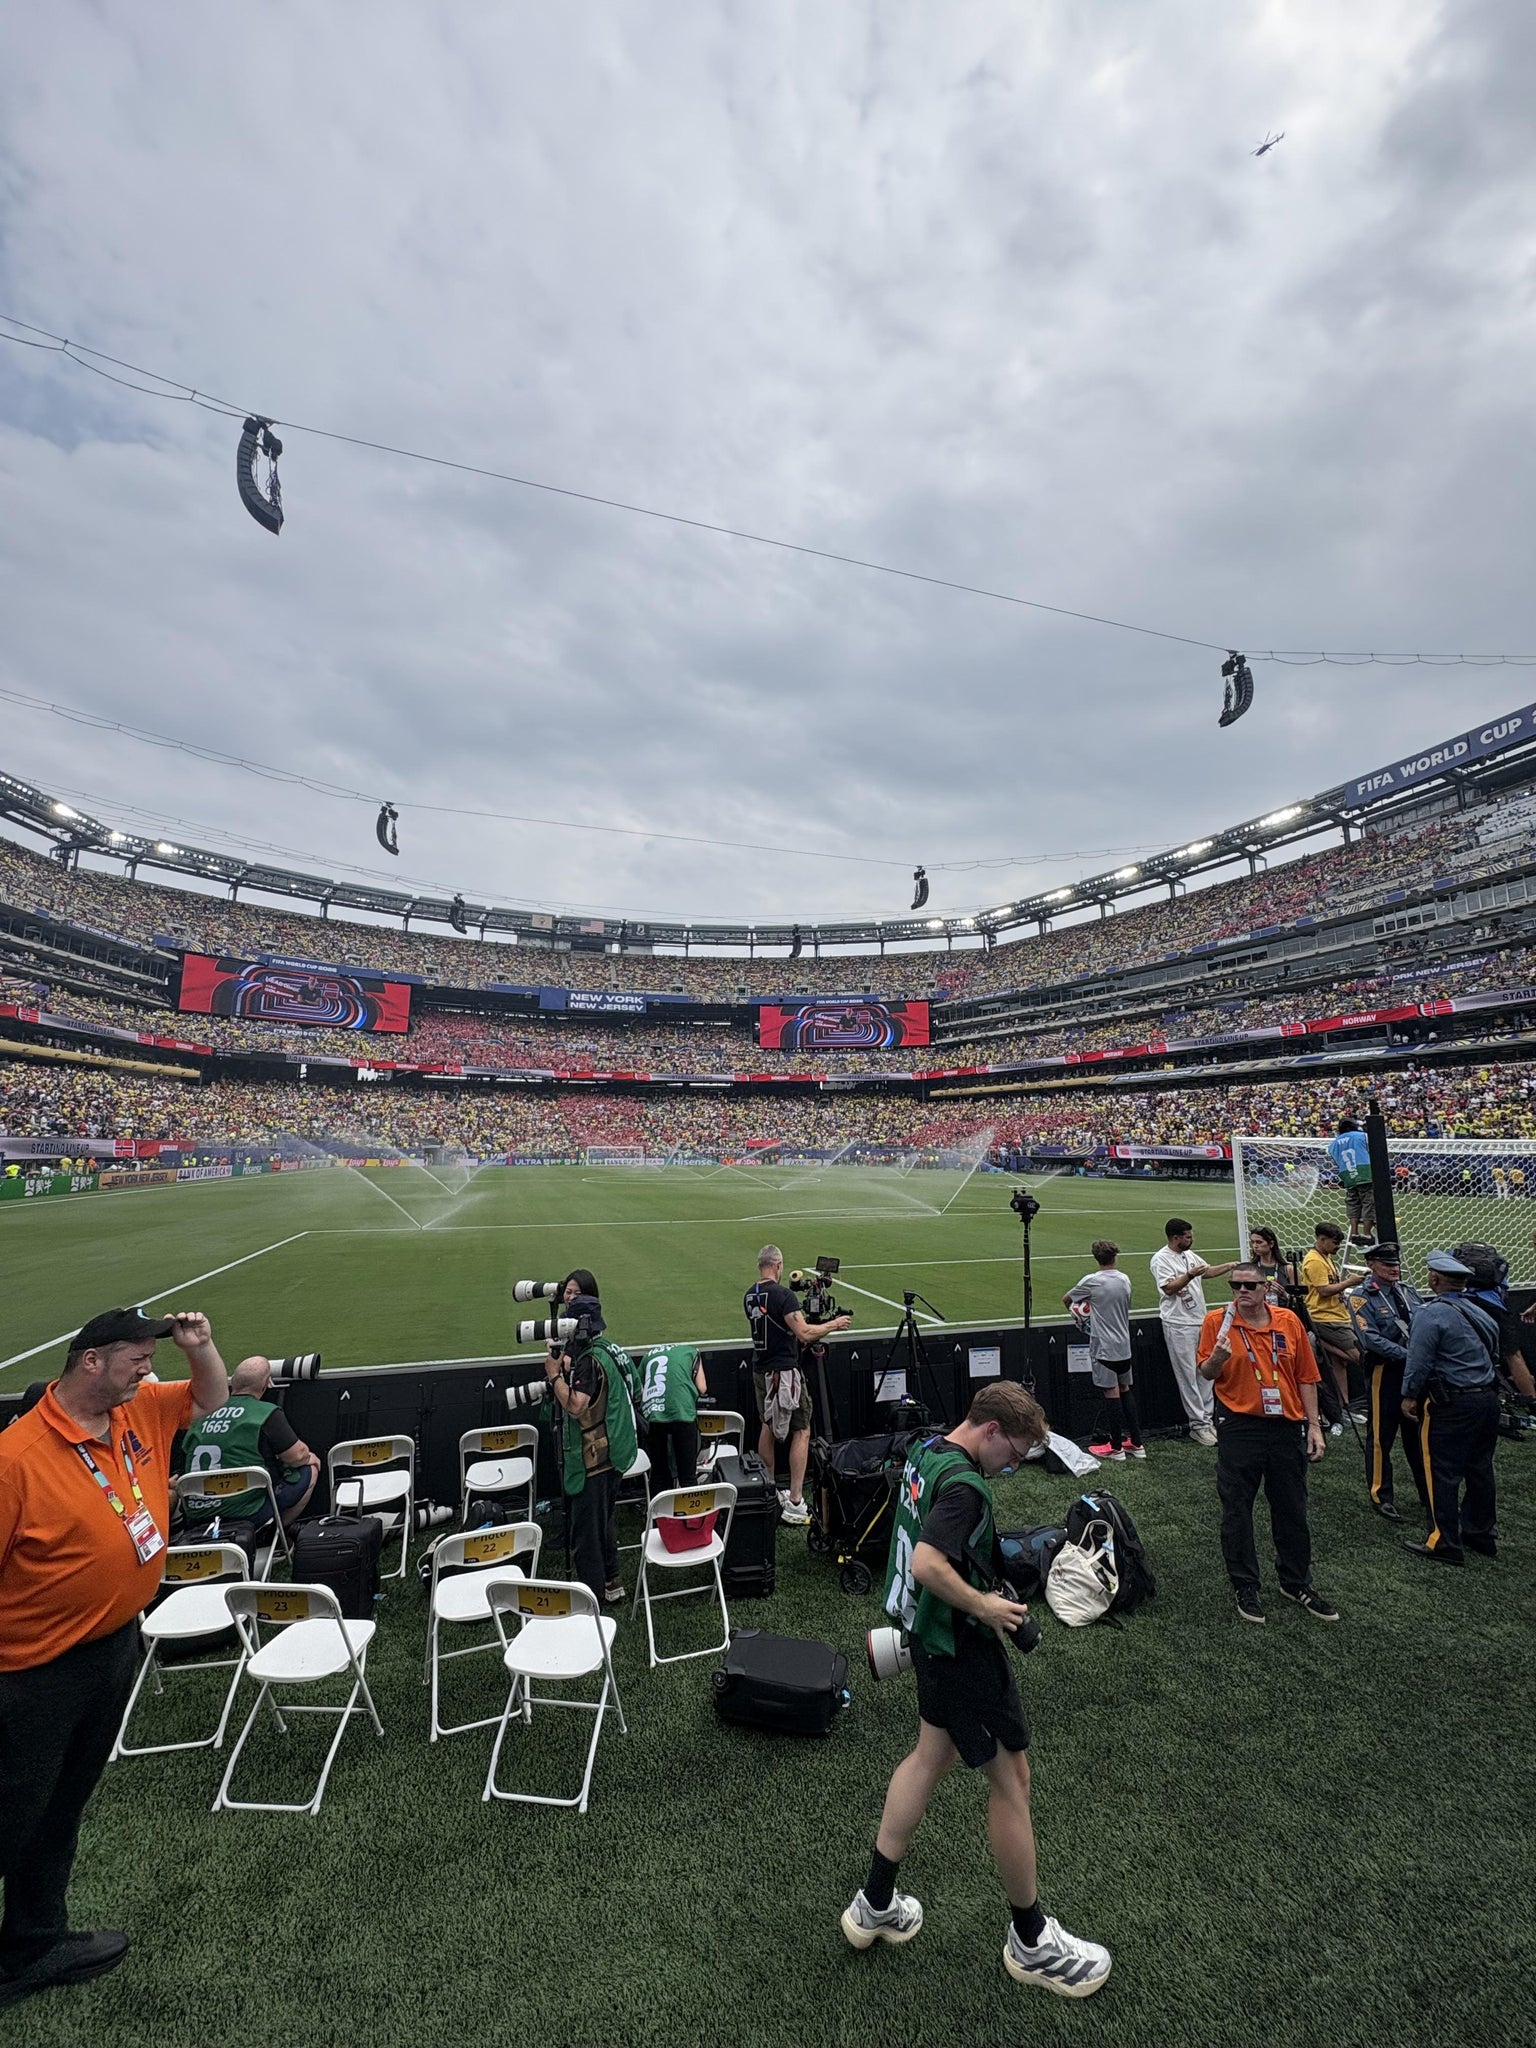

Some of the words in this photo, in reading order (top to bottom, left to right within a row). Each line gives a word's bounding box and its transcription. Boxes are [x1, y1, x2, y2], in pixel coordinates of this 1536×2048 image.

[1357, 772, 1394, 796] FIFA
[1400, 741, 1468, 778] WORLD
[1480, 717, 1522, 745] CUP
[1415, 967, 1441, 977] NEW
[1442, 956, 1489, 971] JERSEY
[570, 993, 603, 1001] NEW
[605, 995, 644, 1004] YORK
[598, 1003, 643, 1011] JERSEY
[1342, 1014, 1377, 1025] NORWAY
[31, 1143, 66, 1154] STARTING
[514, 1158, 542, 1166] ULTRA
[646, 1387, 658, 1396] FIFA
[207, 1406, 245, 1419] OTO
[201, 1420, 231, 1434] 1665
[689, 1500, 701, 1508] 20
[483, 1543, 496, 1553] 22
[185, 1562, 200, 1572] 24
[274, 1601, 288, 1611] 23
[536, 1597, 549, 1607] 21
